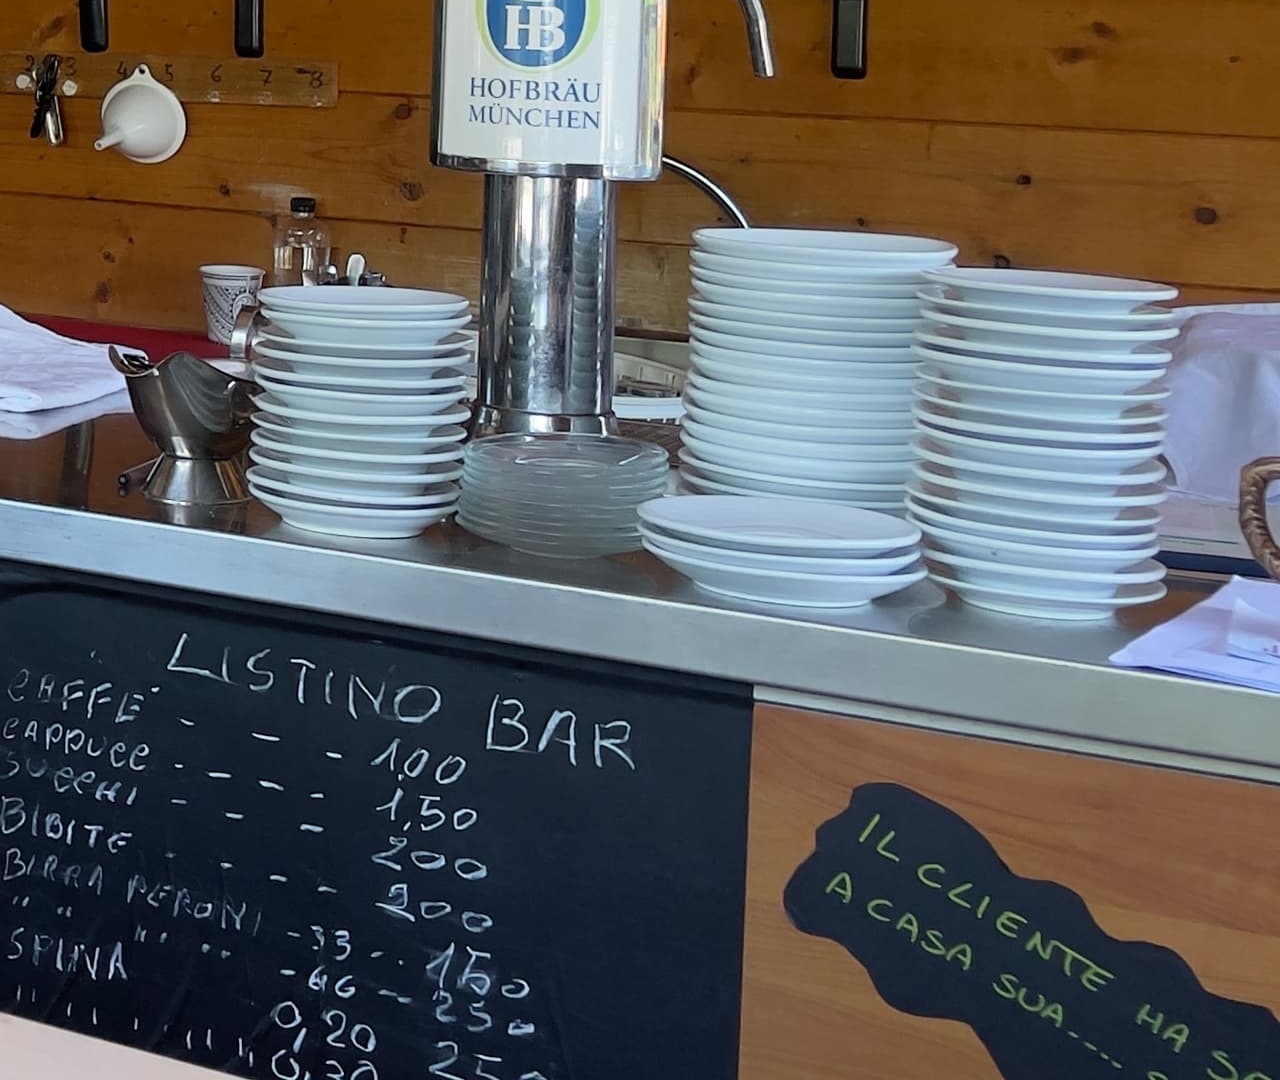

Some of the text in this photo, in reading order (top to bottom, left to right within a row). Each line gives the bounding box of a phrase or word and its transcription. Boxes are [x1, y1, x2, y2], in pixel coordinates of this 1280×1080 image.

[504, 4, 566, 51] HB
[26, 56, 36, 73] 2
[65, 57, 76, 76] 3
[117, 62, 128, 77] 4
[165, 64, 174, 82] 5
[210, 64, 222, 82] 6
[259, 68, 273, 87] 7
[310, 71, 323, 88] 8
[470, 76, 600, 104] HOFBRÄU
[469, 104, 600, 129] MÜNCHEN
[166, 632, 637, 771] LISTINO BAR
[0, 795, 133, 854] BIBITE
[3, 847, 104, 896] BIRRA
[127, 874, 262, 937] PERONI
[825, 872, 854, 903] A
[866, 898, 973, 971] CASA
[859, 814, 900, 862] IL
[916, 862, 1116, 992] CLIENTE
[1136, 1004, 1191, 1053] HA
